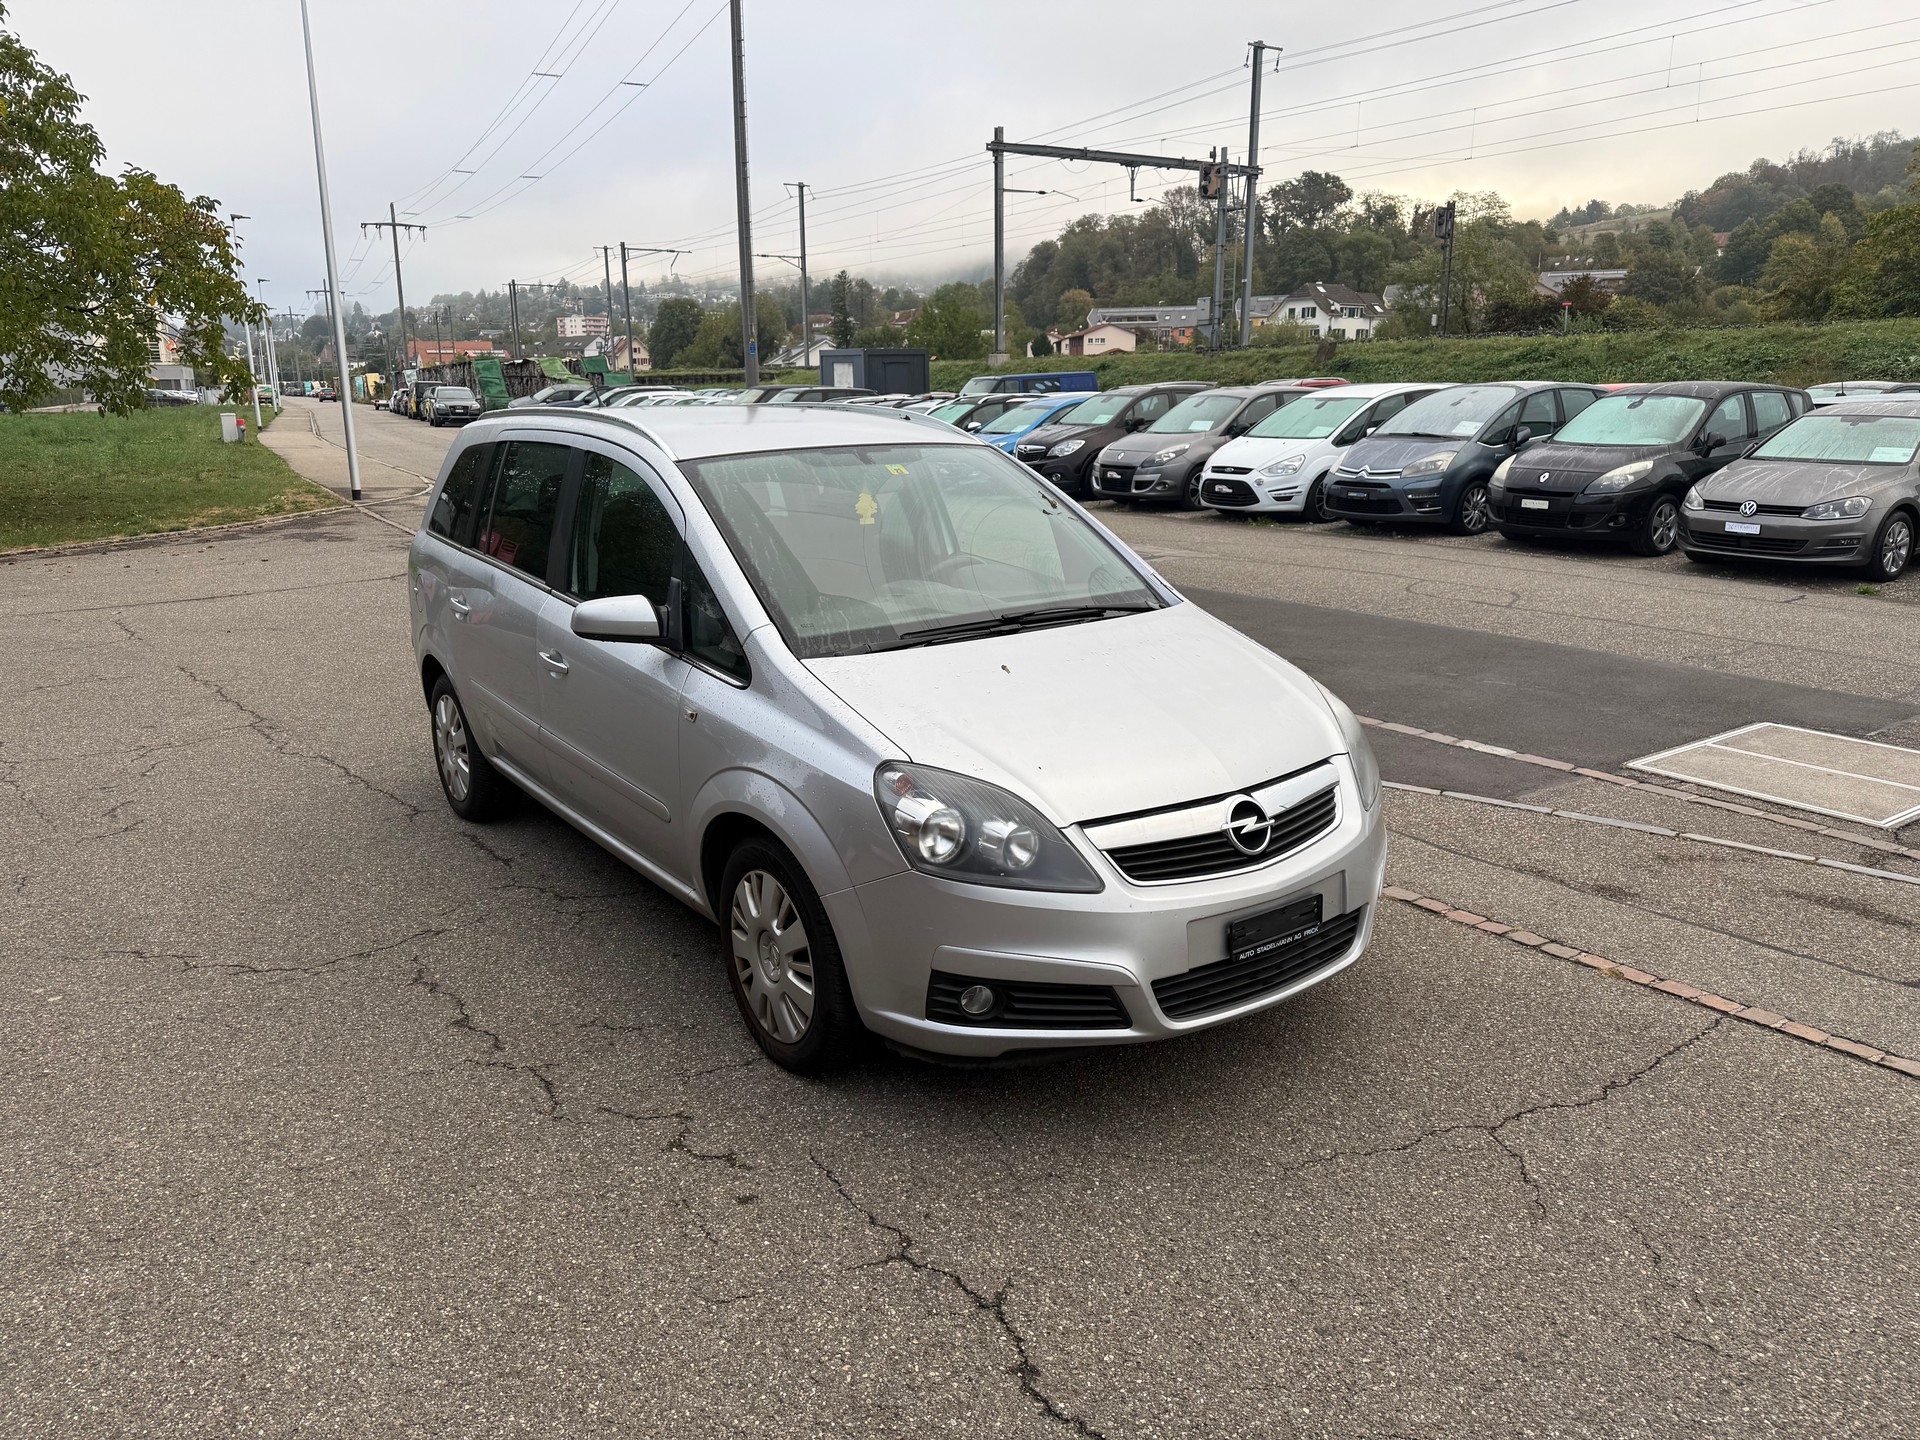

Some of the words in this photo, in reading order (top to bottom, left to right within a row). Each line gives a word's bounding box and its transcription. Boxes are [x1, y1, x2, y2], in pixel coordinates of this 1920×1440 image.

[1239, 950, 1255, 960] AUTO
[1256, 936, 1293, 954] STADELMANN
[1294, 932, 1302, 941] AG
[1303, 926, 1319, 937] FRICK
